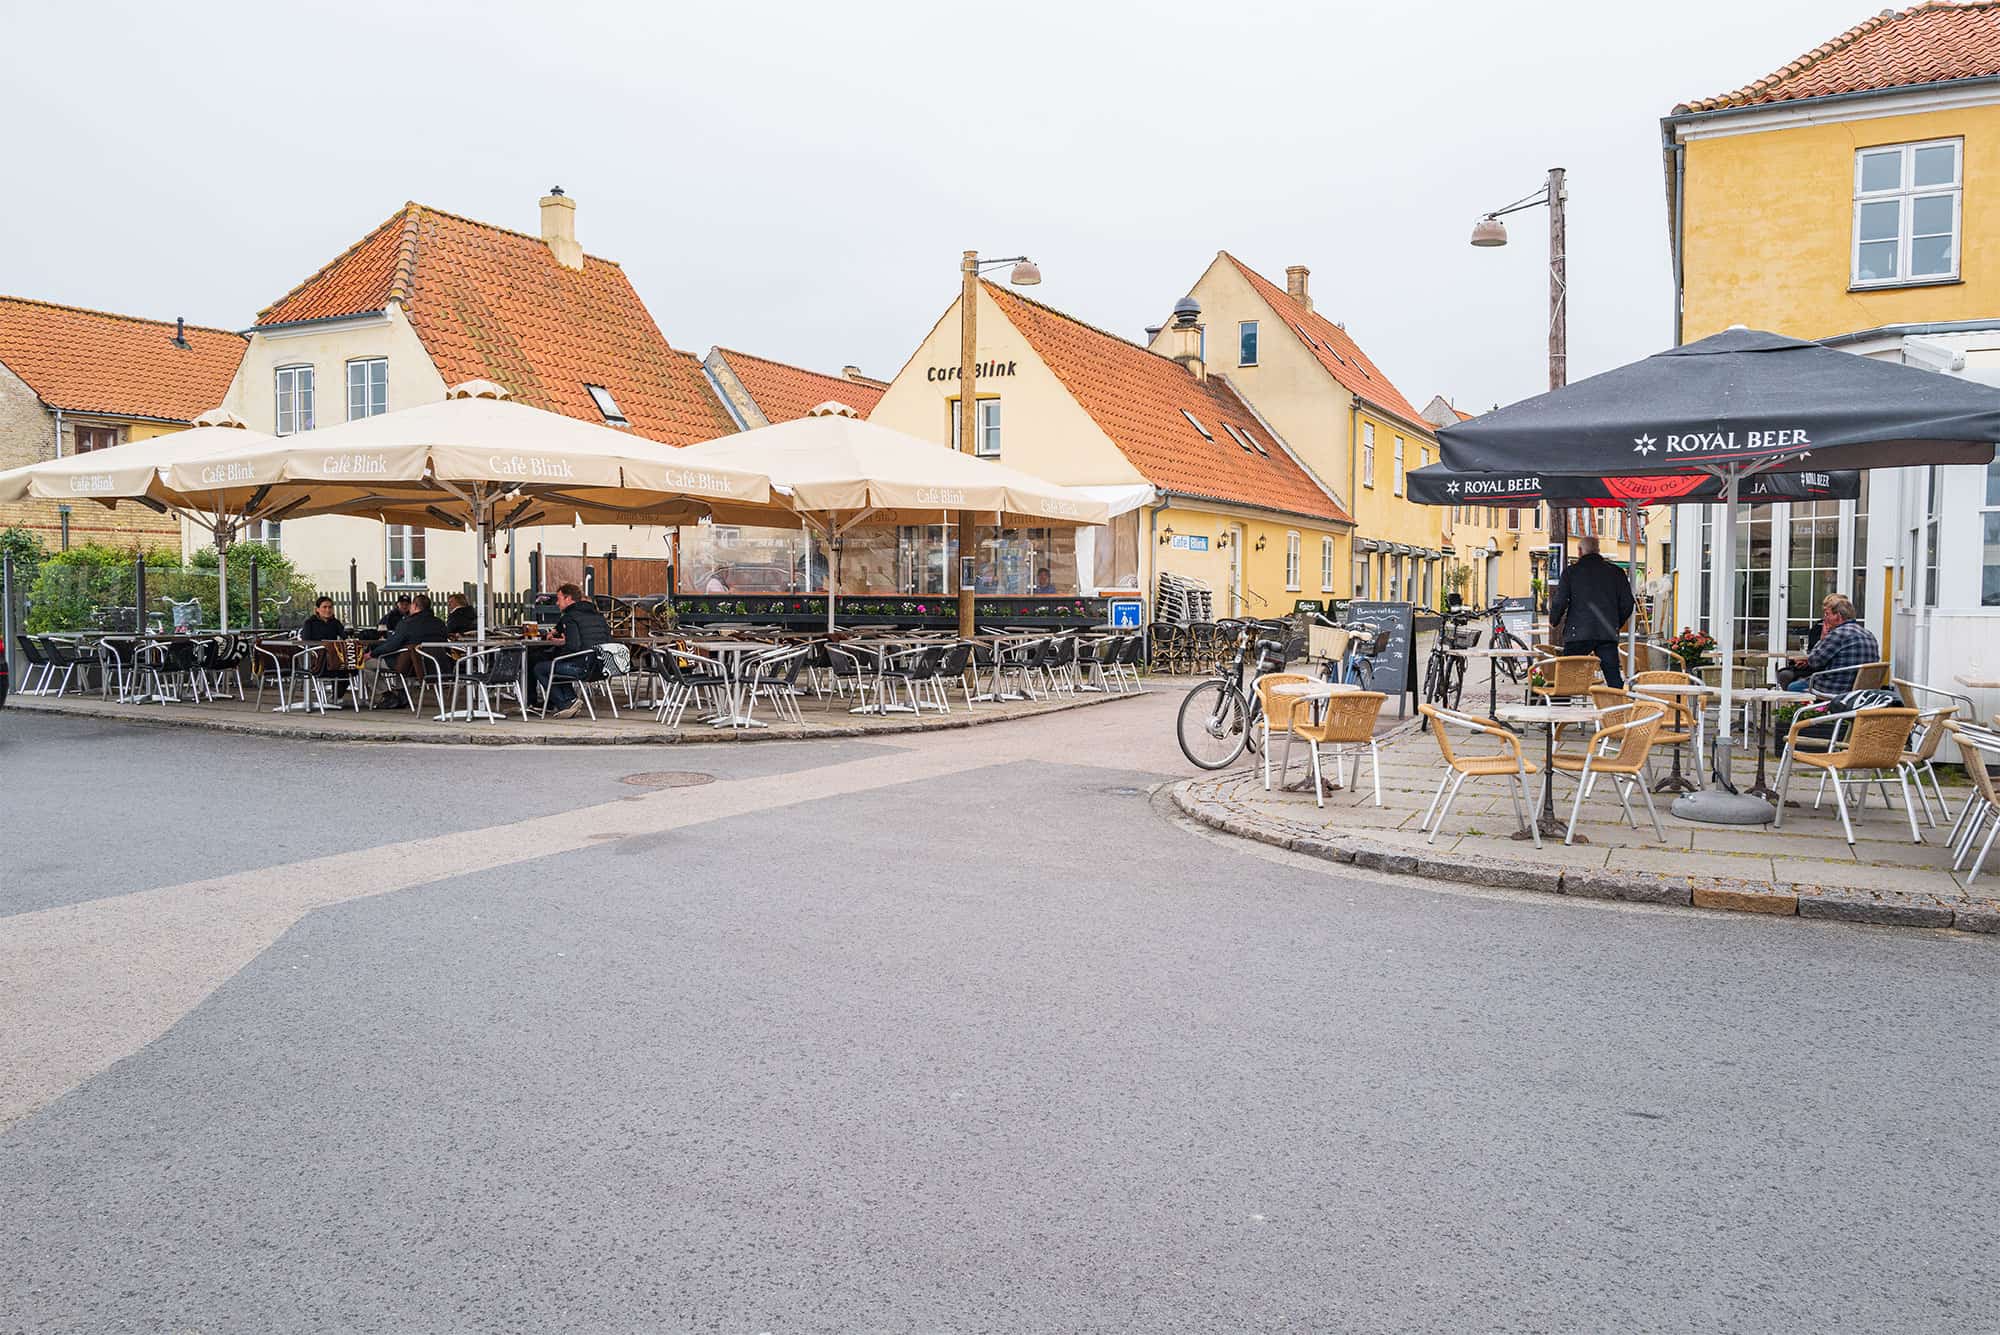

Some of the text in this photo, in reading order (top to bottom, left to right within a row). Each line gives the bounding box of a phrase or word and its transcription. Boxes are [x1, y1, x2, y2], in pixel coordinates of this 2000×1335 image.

[1666, 429, 1812, 453] ROYAL BEER
[202, 461, 255, 484] Café Blink
[323, 455, 386, 473] Café Blink
[489, 456, 574, 479] Café Blink
[665, 470, 732, 493] Café Blink
[1464, 477, 1542, 494] ROYAL BEER
